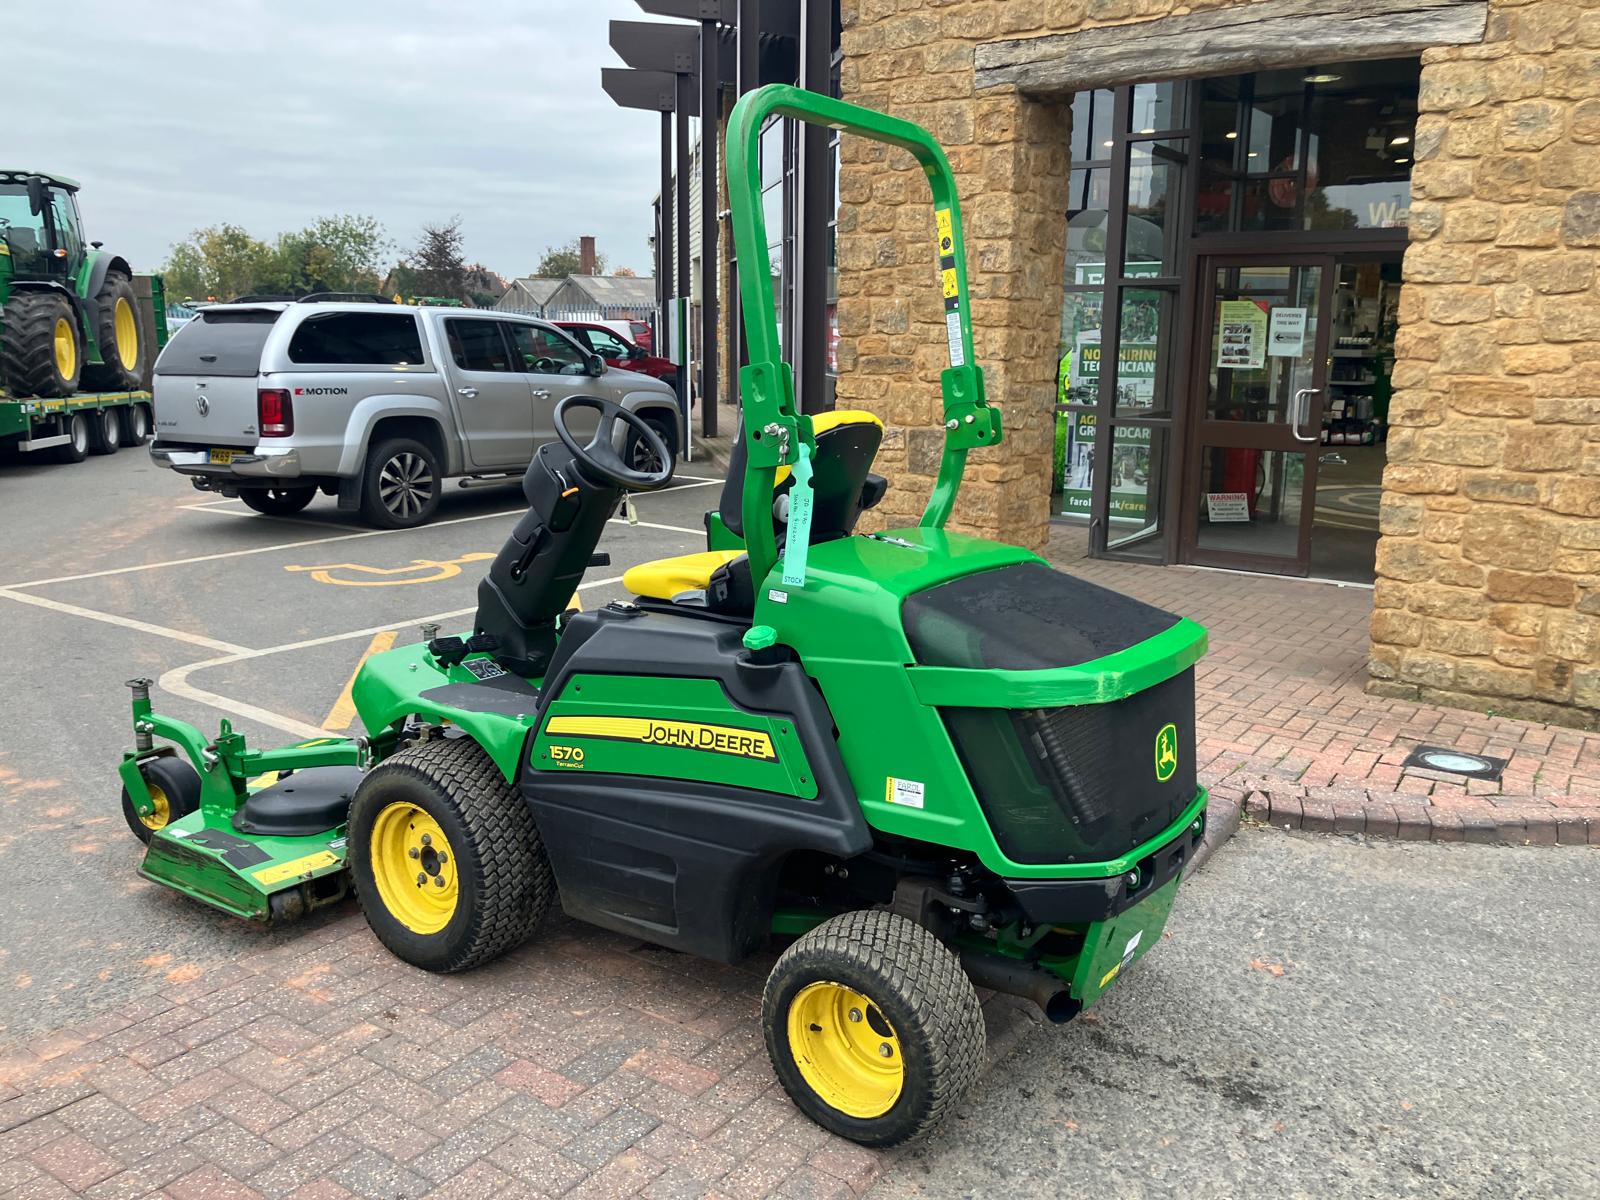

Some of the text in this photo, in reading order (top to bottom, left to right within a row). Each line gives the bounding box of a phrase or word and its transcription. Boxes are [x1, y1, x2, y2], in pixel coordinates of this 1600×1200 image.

[1083, 348, 1157, 360] NO HIRIN
[1079, 425, 1152, 439] GRNDCAR
[784, 575, 803, 584] STOCK
[642, 722, 765, 755] JOHN DEERE
[549, 745, 585, 762] 1570
[556, 761, 585, 769] TerrainCut
